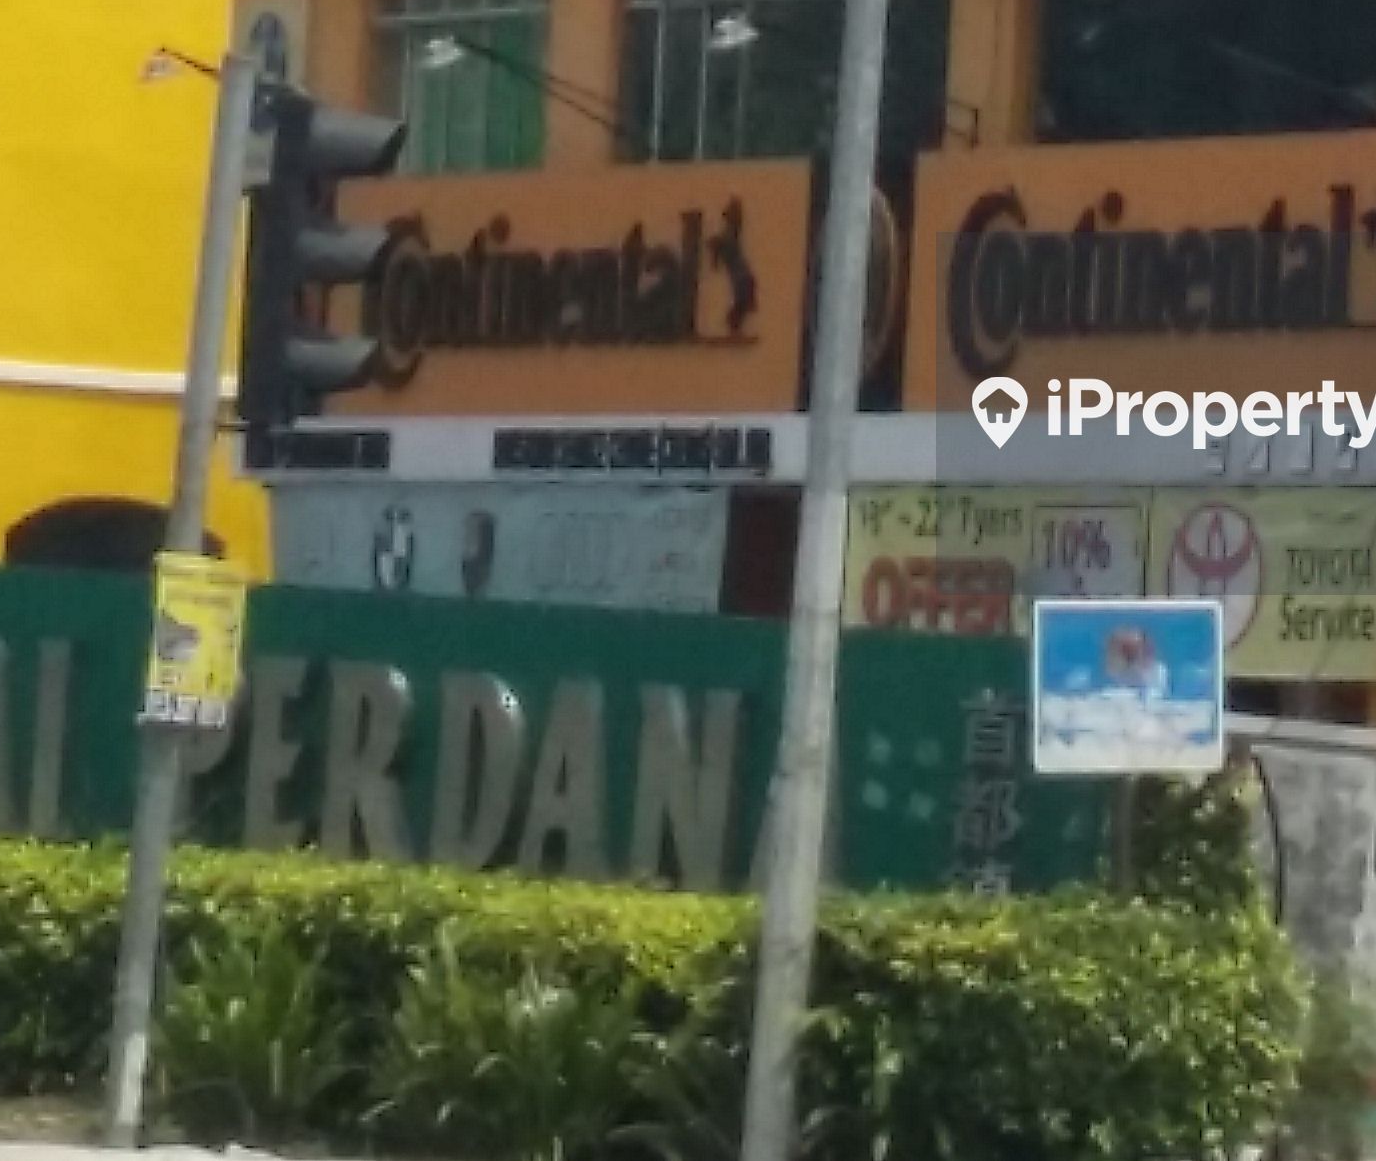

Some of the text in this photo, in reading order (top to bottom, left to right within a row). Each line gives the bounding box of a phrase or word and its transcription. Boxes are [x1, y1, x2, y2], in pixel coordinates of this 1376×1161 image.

[364, 209, 701, 390] Continental
[949, 185, 1354, 378] Continental
[862, 555, 1016, 635] OFFER
[1280, 596, 1376, 643] Service
